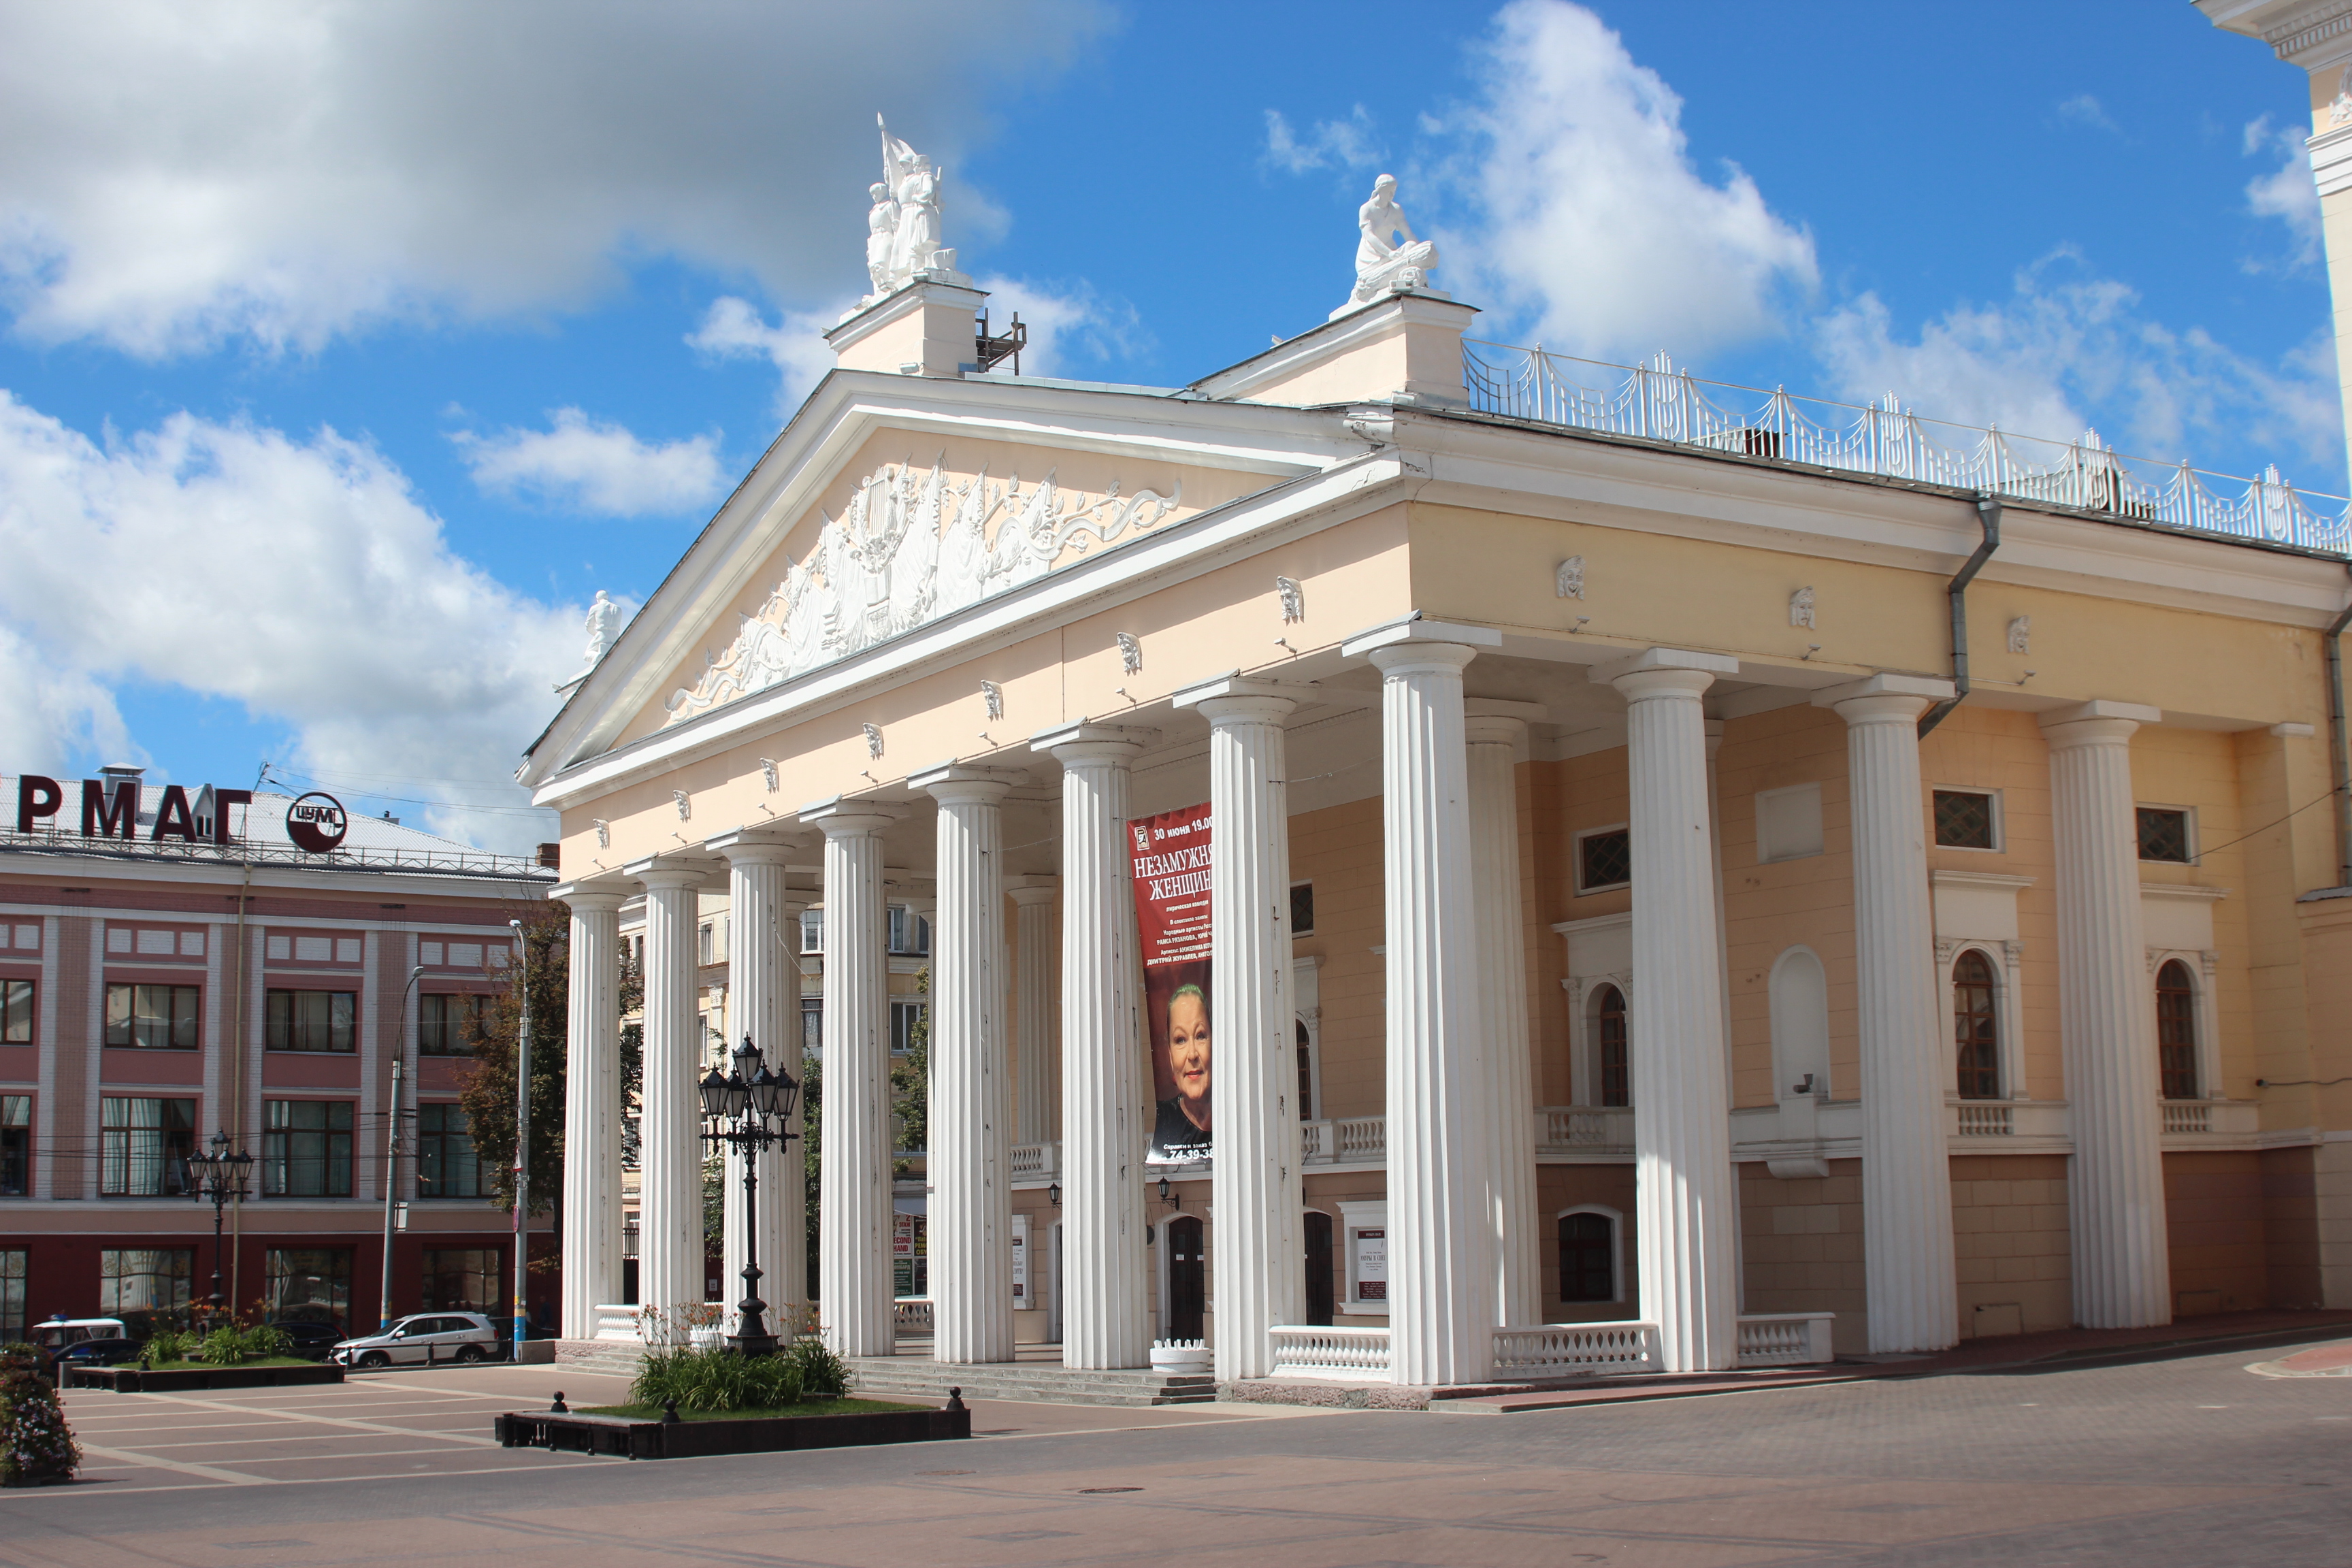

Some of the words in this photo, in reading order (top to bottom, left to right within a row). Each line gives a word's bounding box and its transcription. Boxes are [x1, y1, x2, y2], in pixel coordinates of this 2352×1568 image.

[296, 808, 333, 823] ЦУМ
[1154, 828, 1165, 840] 30
[1167, 825, 1190, 838] июня
[1166, 903, 1192, 912] лирическая
[1174, 916, 1194, 924] спектакле
[1163, 928, 1186, 936] Народные
[1186, 925, 1203, 933] артисты
[1172, 934, 1197, 943] РЯЗАНОВА,
[1179, 945, 1203, 953] АНЖЕЛИКА
[1147, 956, 1172, 966] ДМИТРИЙ
[1173, 953, 1197, 962] ЖУРАВЛЕВ,
